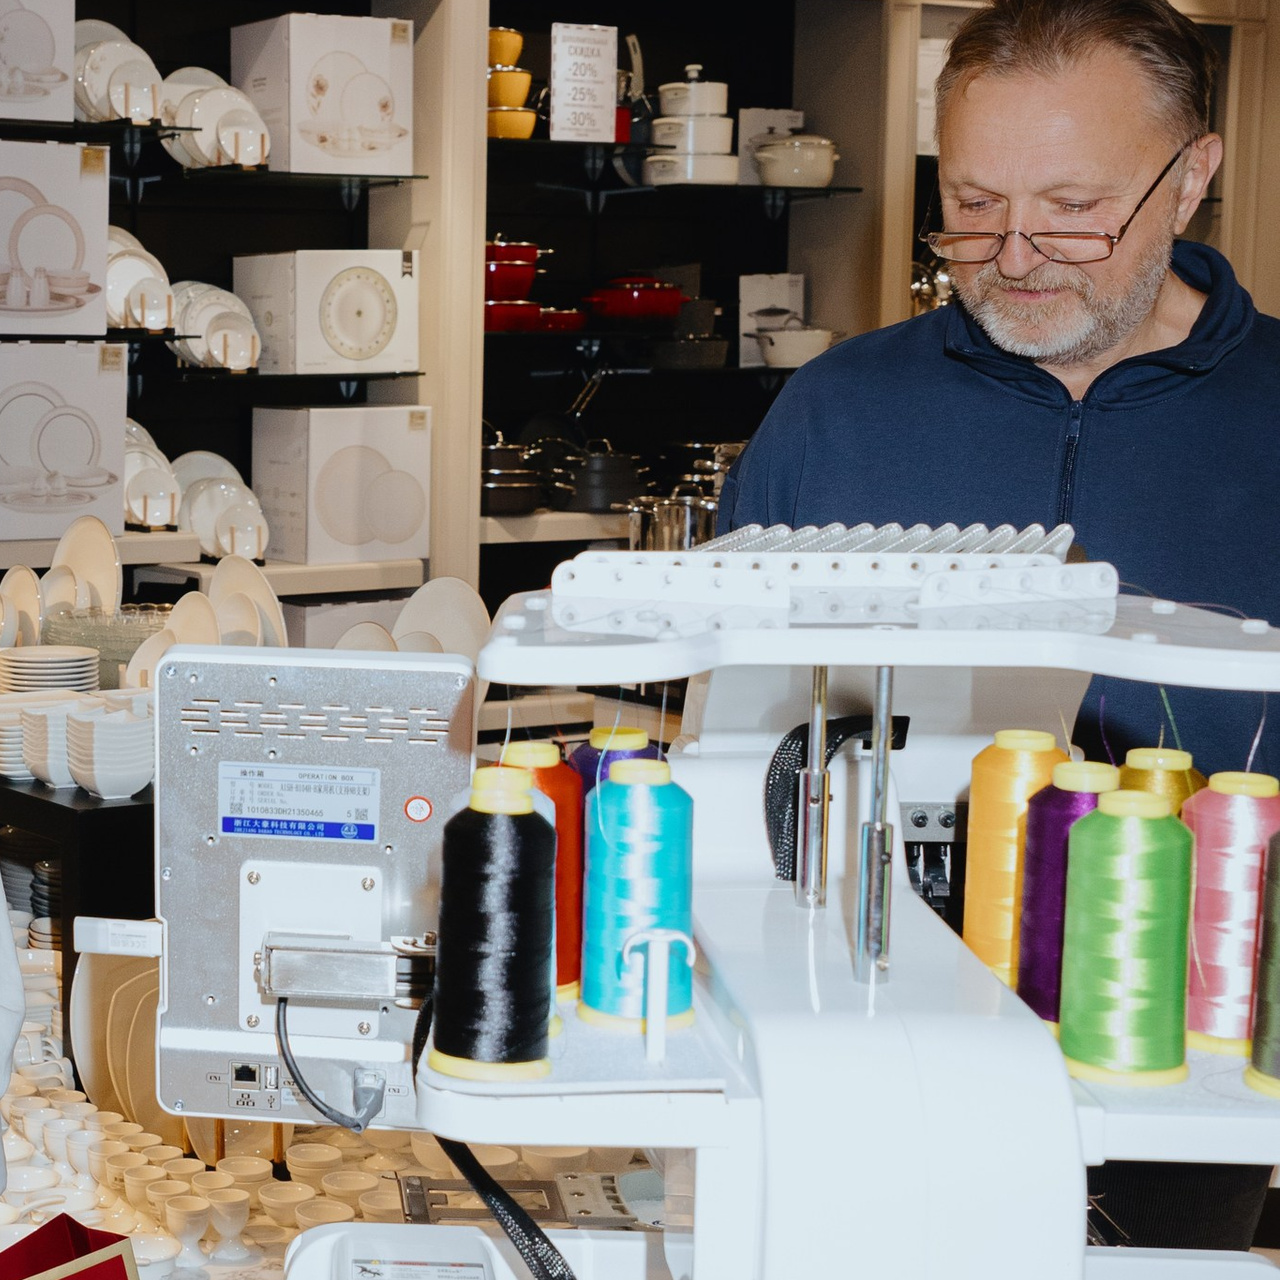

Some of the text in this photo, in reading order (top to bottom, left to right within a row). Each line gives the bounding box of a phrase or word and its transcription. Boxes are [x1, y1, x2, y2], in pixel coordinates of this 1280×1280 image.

[568, 62, 597, 78] -20%
[568, 87, 597, 102] -25%
[567, 112, 596, 127] -30%
[298, 773, 338, 781] OPERATION
